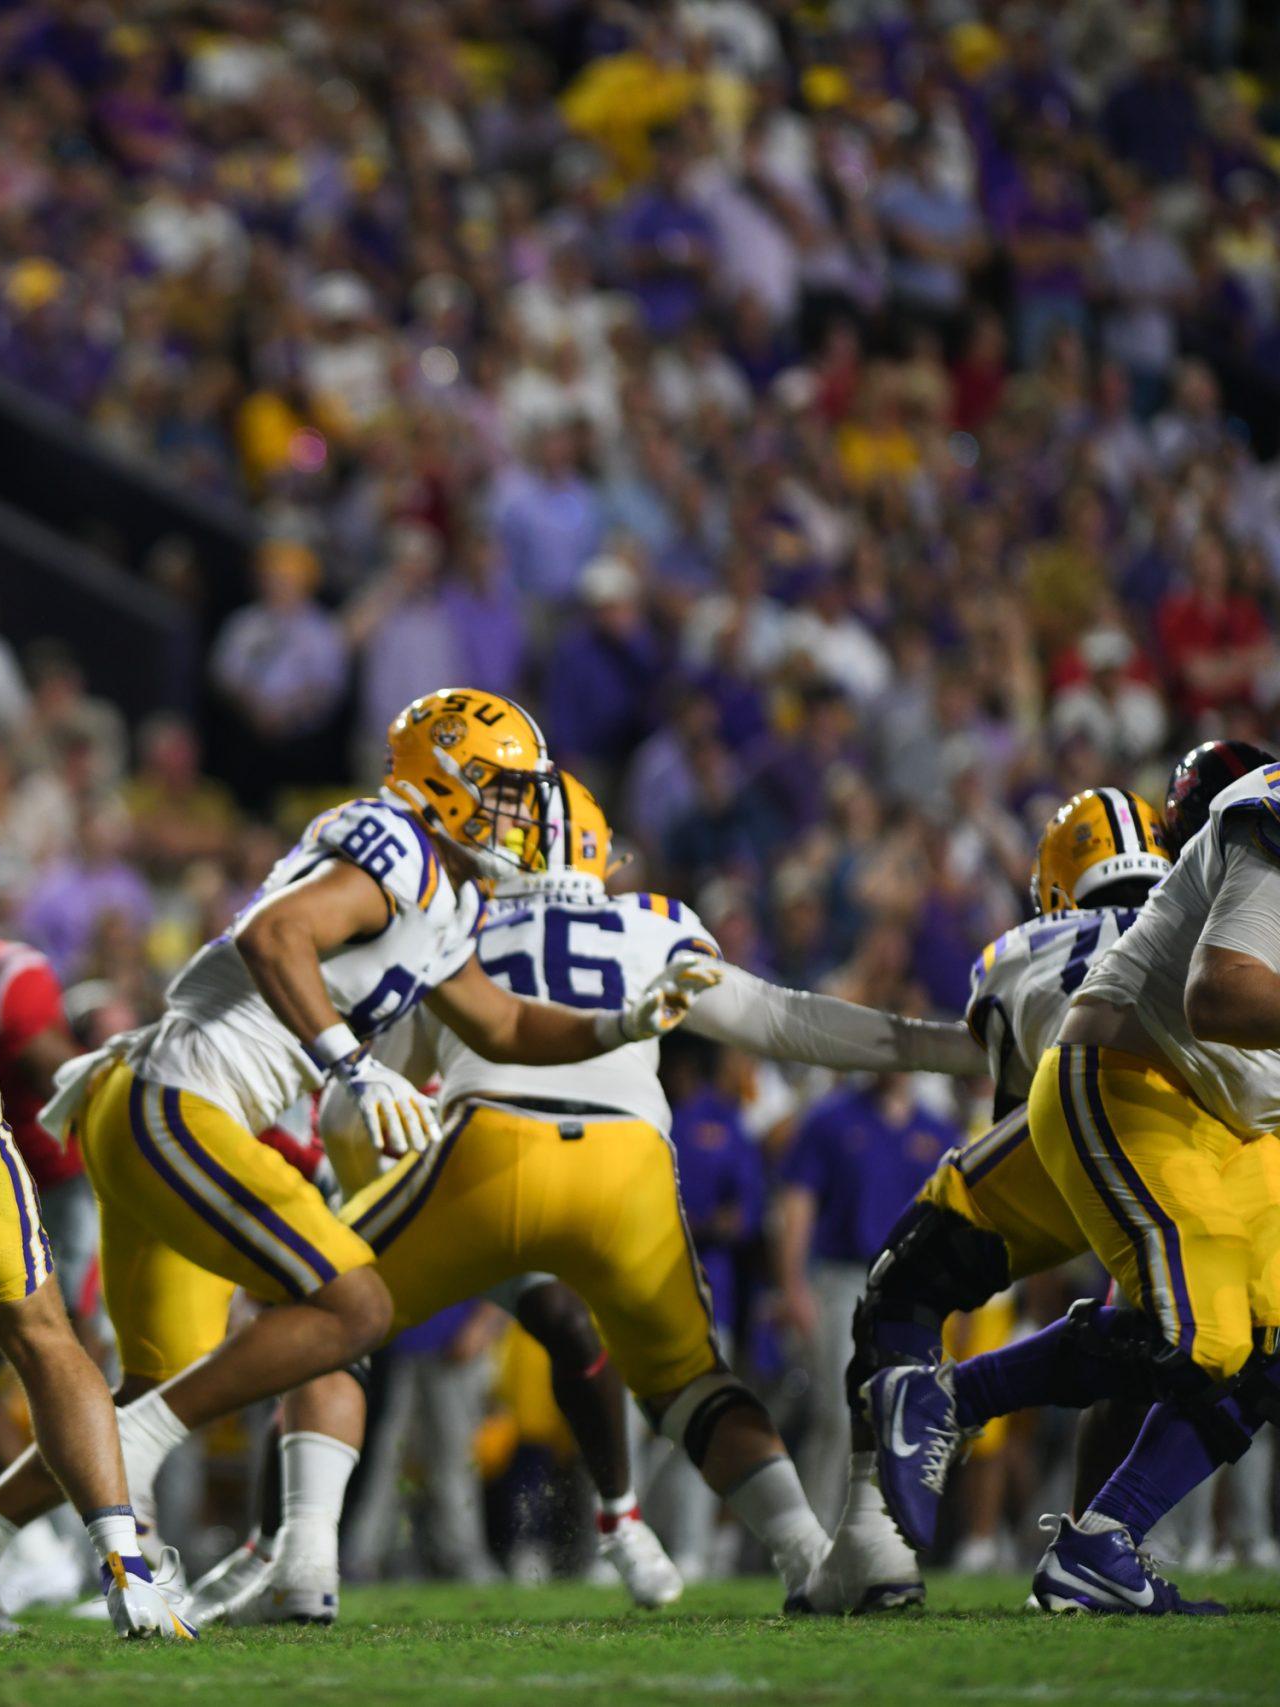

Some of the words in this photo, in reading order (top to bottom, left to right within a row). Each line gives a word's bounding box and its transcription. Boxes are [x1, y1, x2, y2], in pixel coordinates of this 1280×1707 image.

[340, 815, 408, 879] 86
[1102, 858, 1170, 875] TIGERS
[477, 905, 626, 1011] 56
